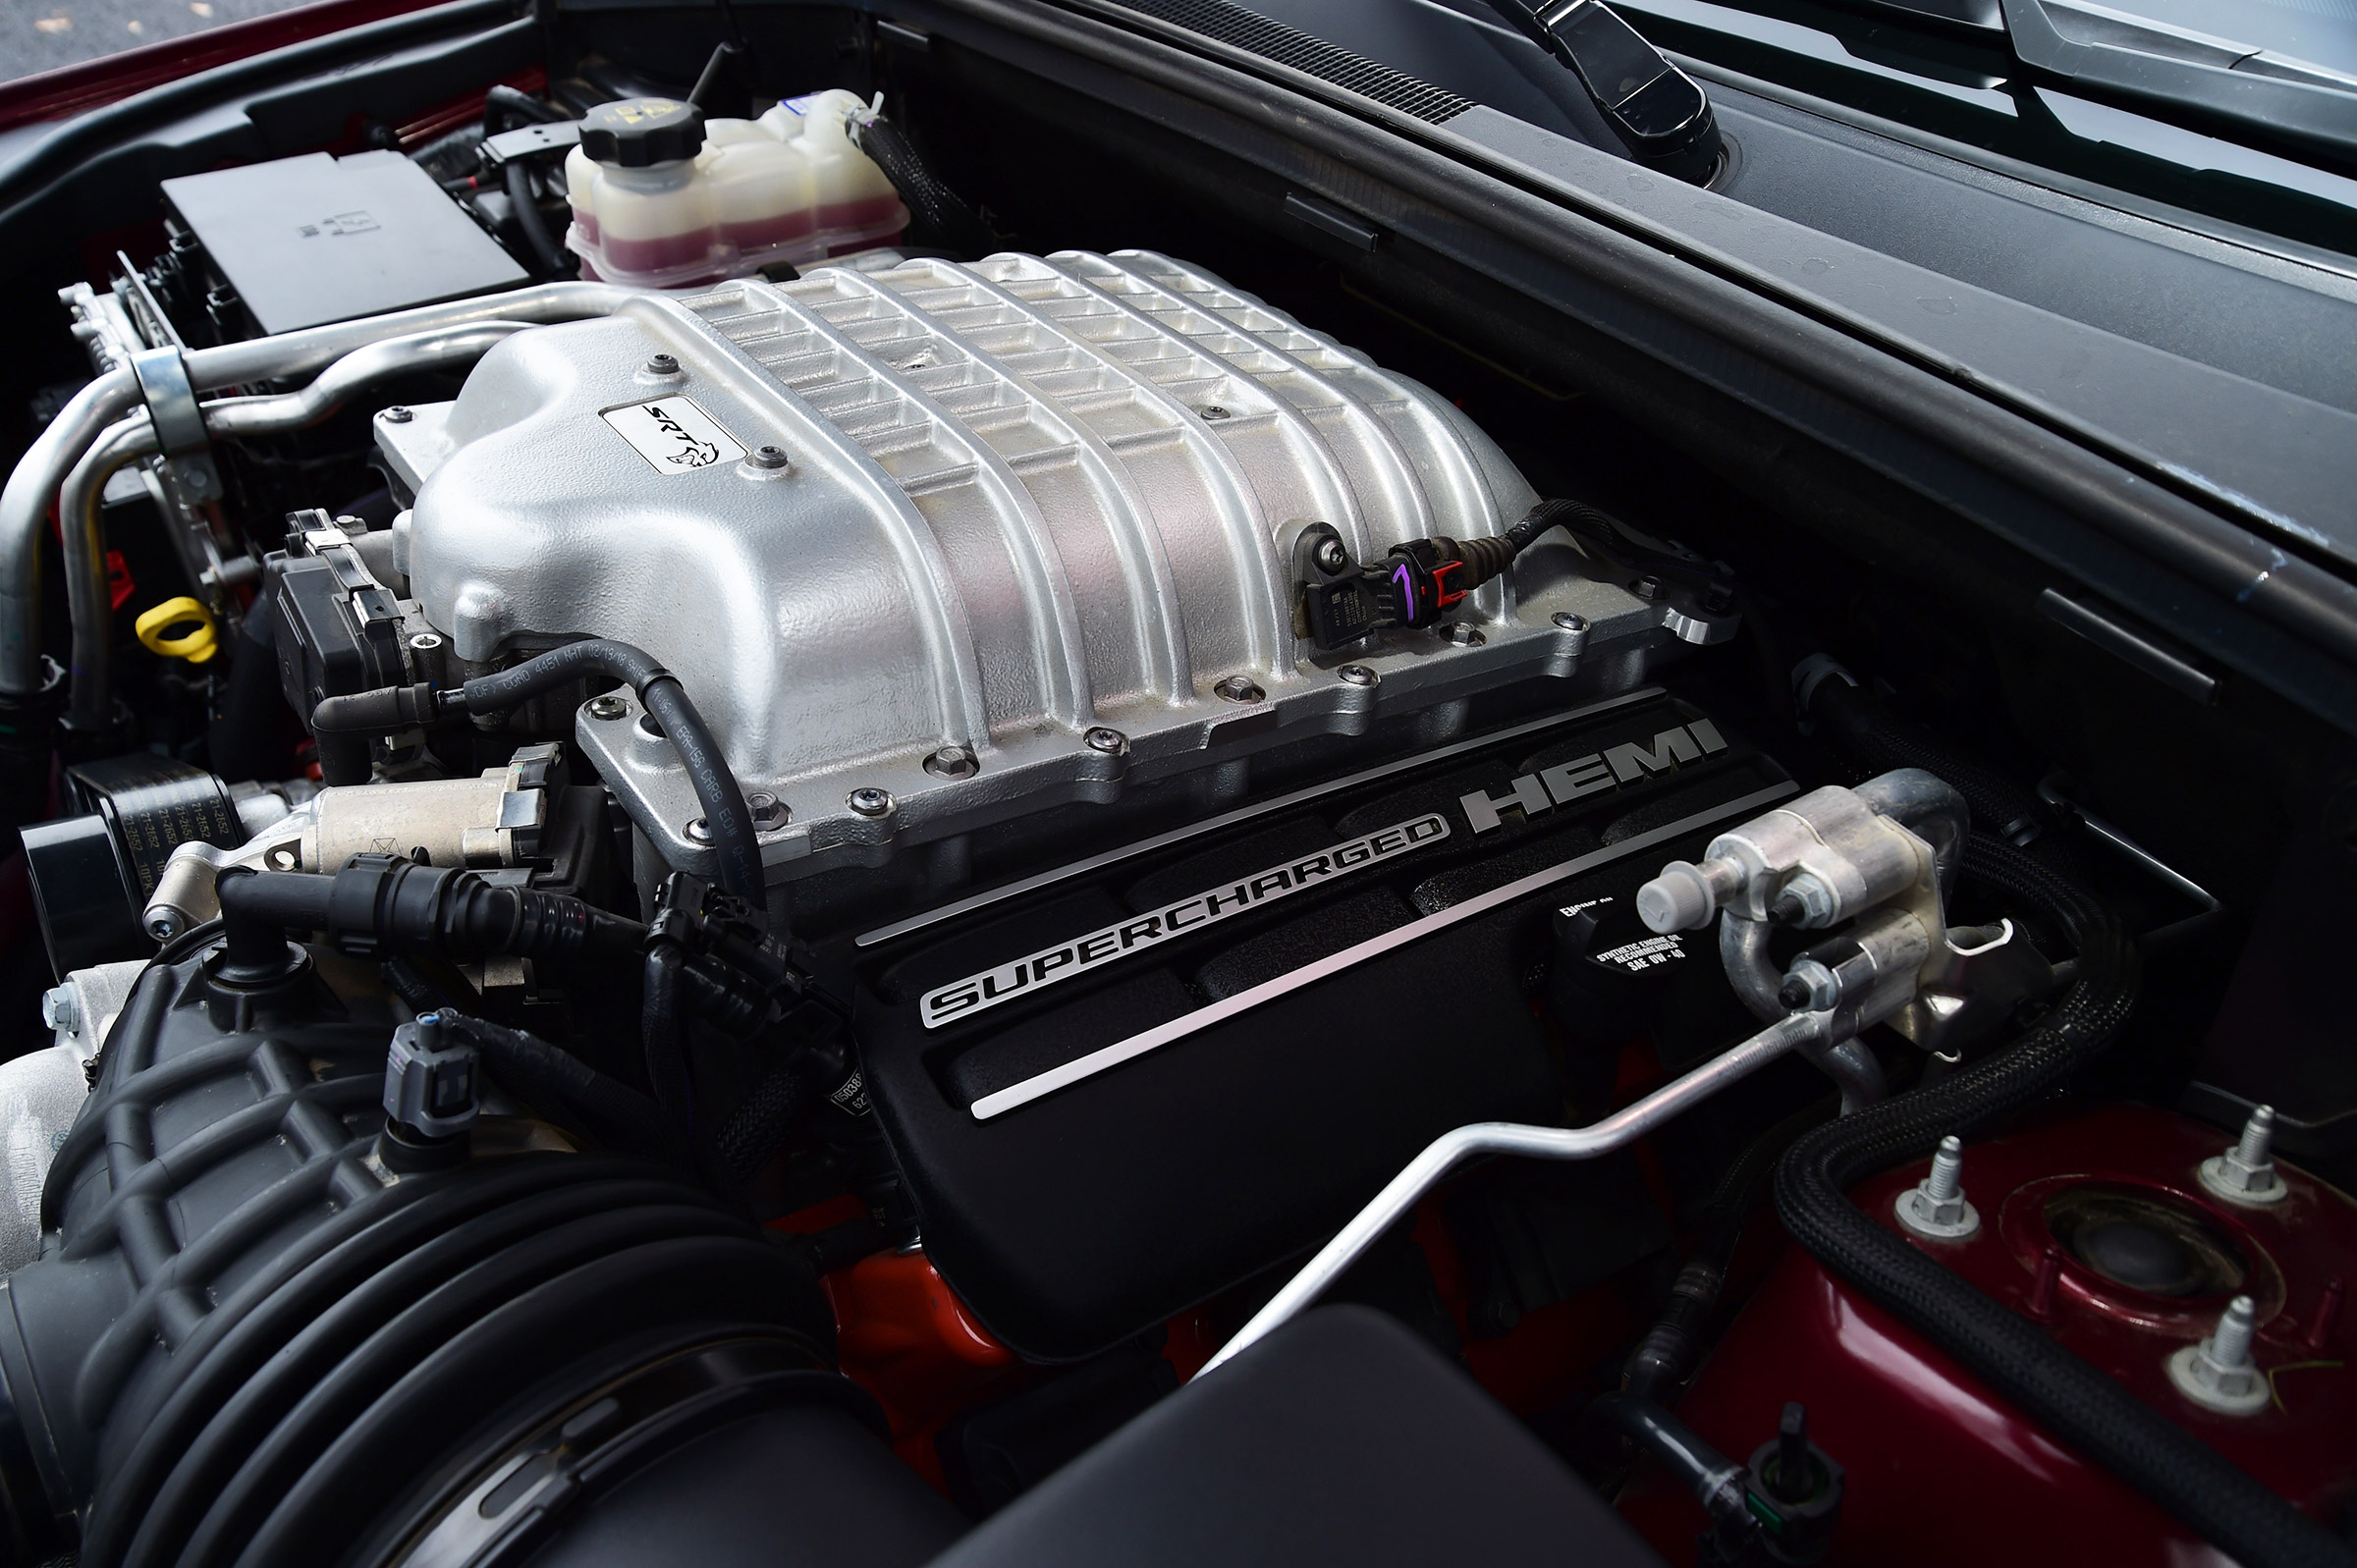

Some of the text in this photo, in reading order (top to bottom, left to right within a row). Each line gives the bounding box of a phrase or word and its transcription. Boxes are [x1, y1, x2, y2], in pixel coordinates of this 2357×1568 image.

[641, 405, 699, 446] SRT
[534, 654, 560, 676] 4451
[587, 643, 628, 667] 02/19/18
[675, 724, 706, 769] EPA-15G
[699, 769, 724, 803] CARB
[718, 806, 739, 838] EO#
[1459, 717, 1729, 835] HEMI
[123, 815, 143, 852] 21-2652
[139, 812, 160, 849] 21-2652
[157, 808, 179, 845] 21-2652
[191, 802, 212, 838] 21-2652
[209, 798, 230, 836] 21-2652
[139, 863, 155, 897] 10PK
[928, 816, 1444, 1021] SUPERCHARGED
[1596, 943, 1639, 962] SYNTHETIC
[1639, 936, 1670, 947] ENGINE
[1614, 942, 1678, 963] RECOMMENDED
[1626, 957, 1651, 972] SAE
